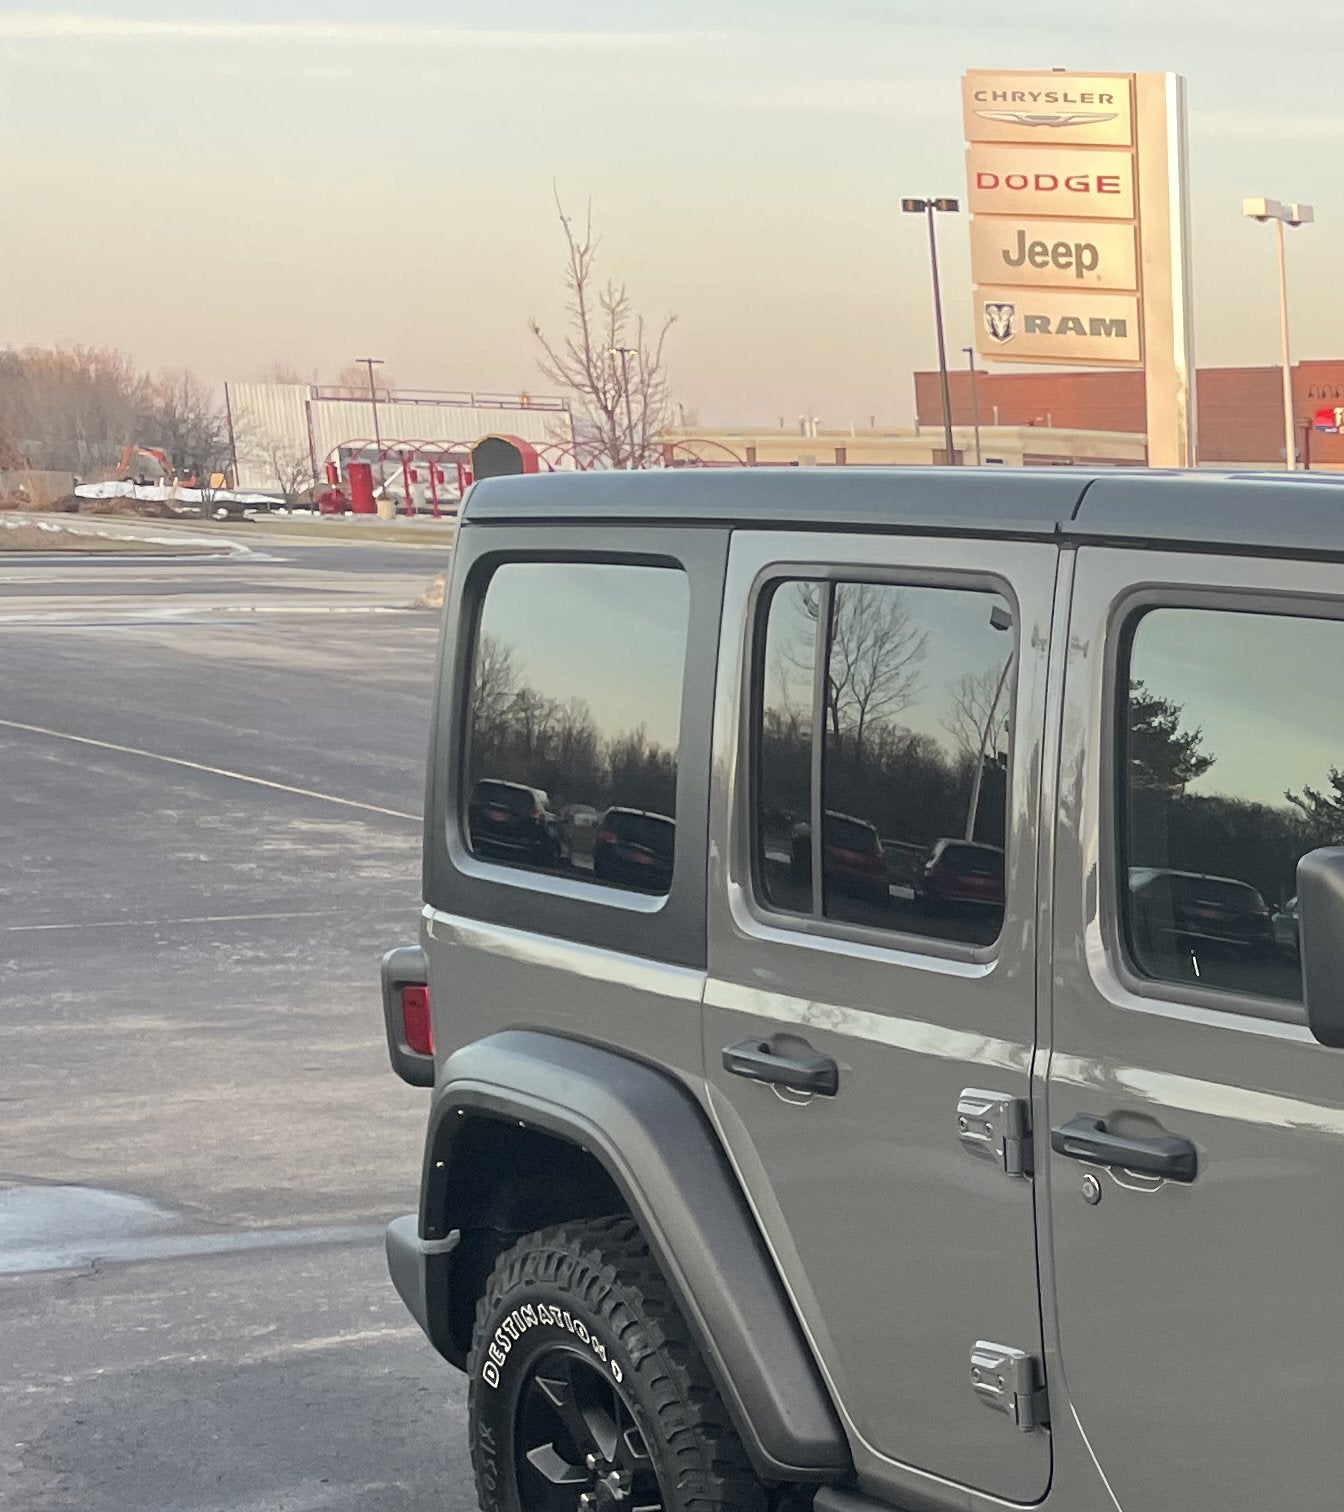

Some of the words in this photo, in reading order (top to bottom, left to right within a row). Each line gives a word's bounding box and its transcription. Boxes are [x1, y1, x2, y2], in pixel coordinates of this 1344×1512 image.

[974, 90, 1114, 104] CHRYSLER
[976, 172, 1121, 194] DODGE
[1002, 229, 1099, 279] Jeep
[1023, 314, 1128, 338] RAM
[482, 1303, 608, 1389] DESTINATION
